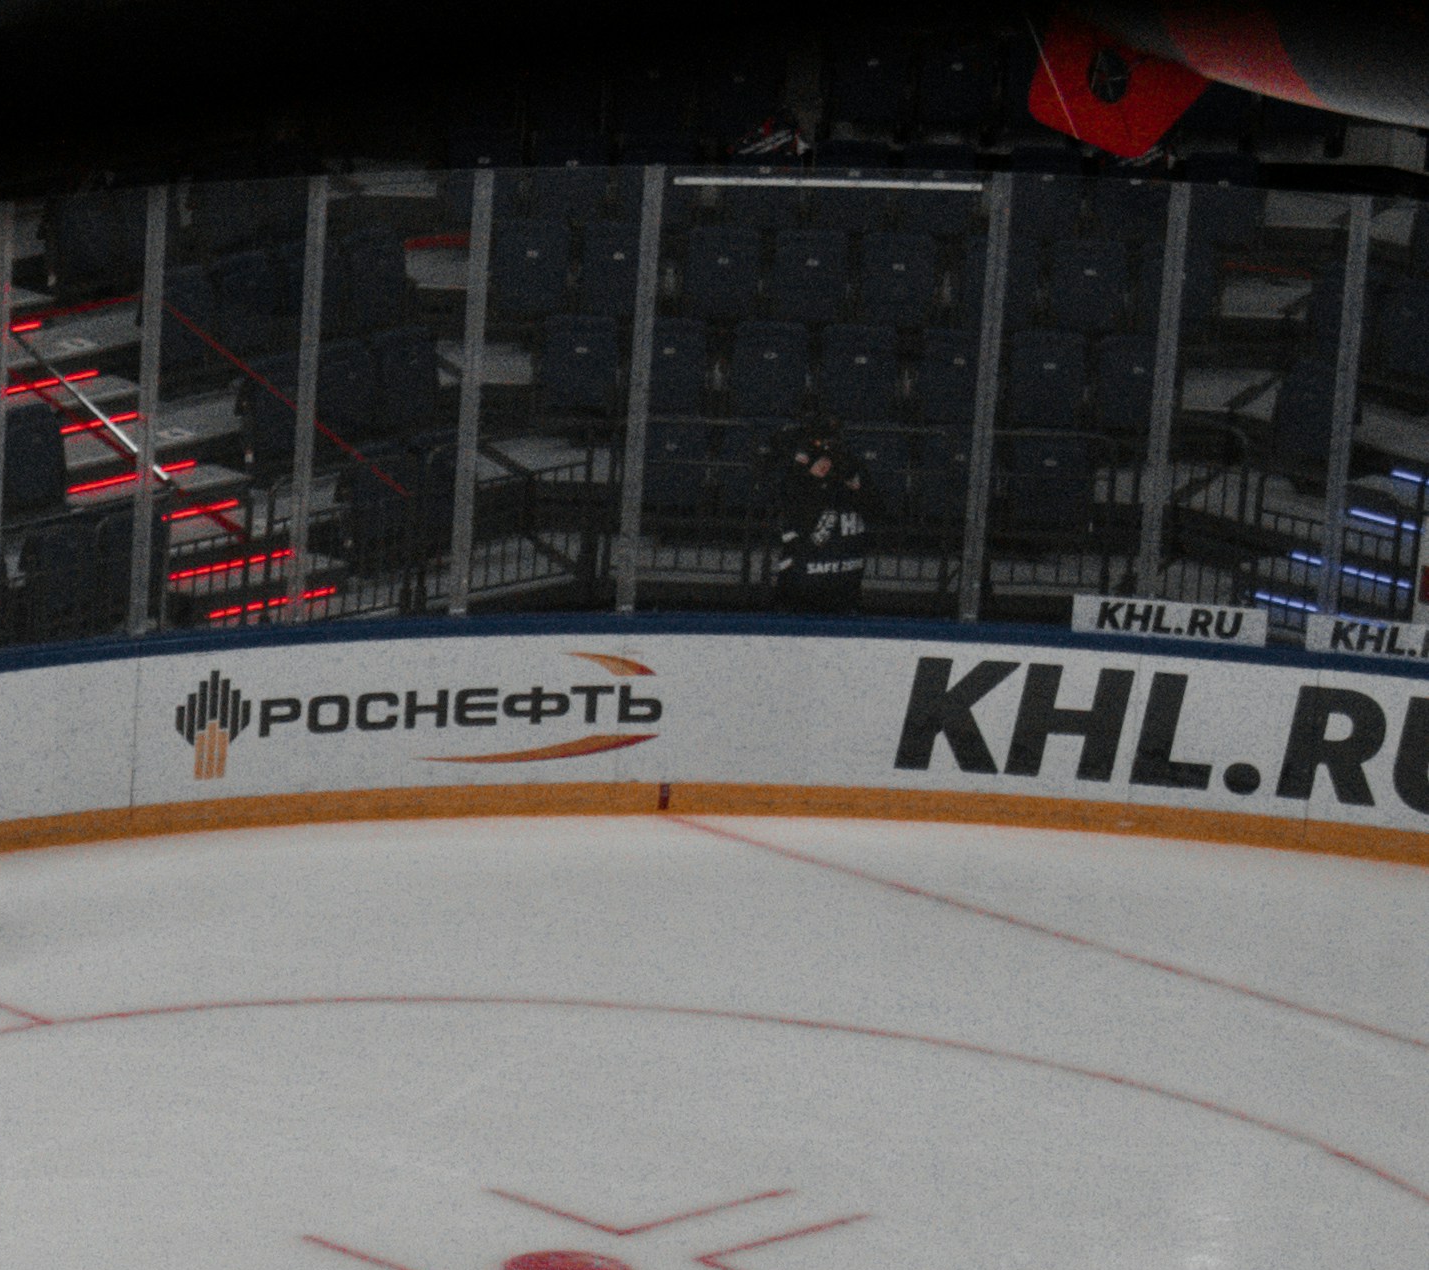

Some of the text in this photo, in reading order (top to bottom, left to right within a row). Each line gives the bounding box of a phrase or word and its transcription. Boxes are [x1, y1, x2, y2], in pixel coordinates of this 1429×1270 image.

[1095, 600, 1244, 641] KHL.RU
[1329, 620, 1429, 659] KHL.
[258, 684, 664, 738] РОСНЕФТЬ
